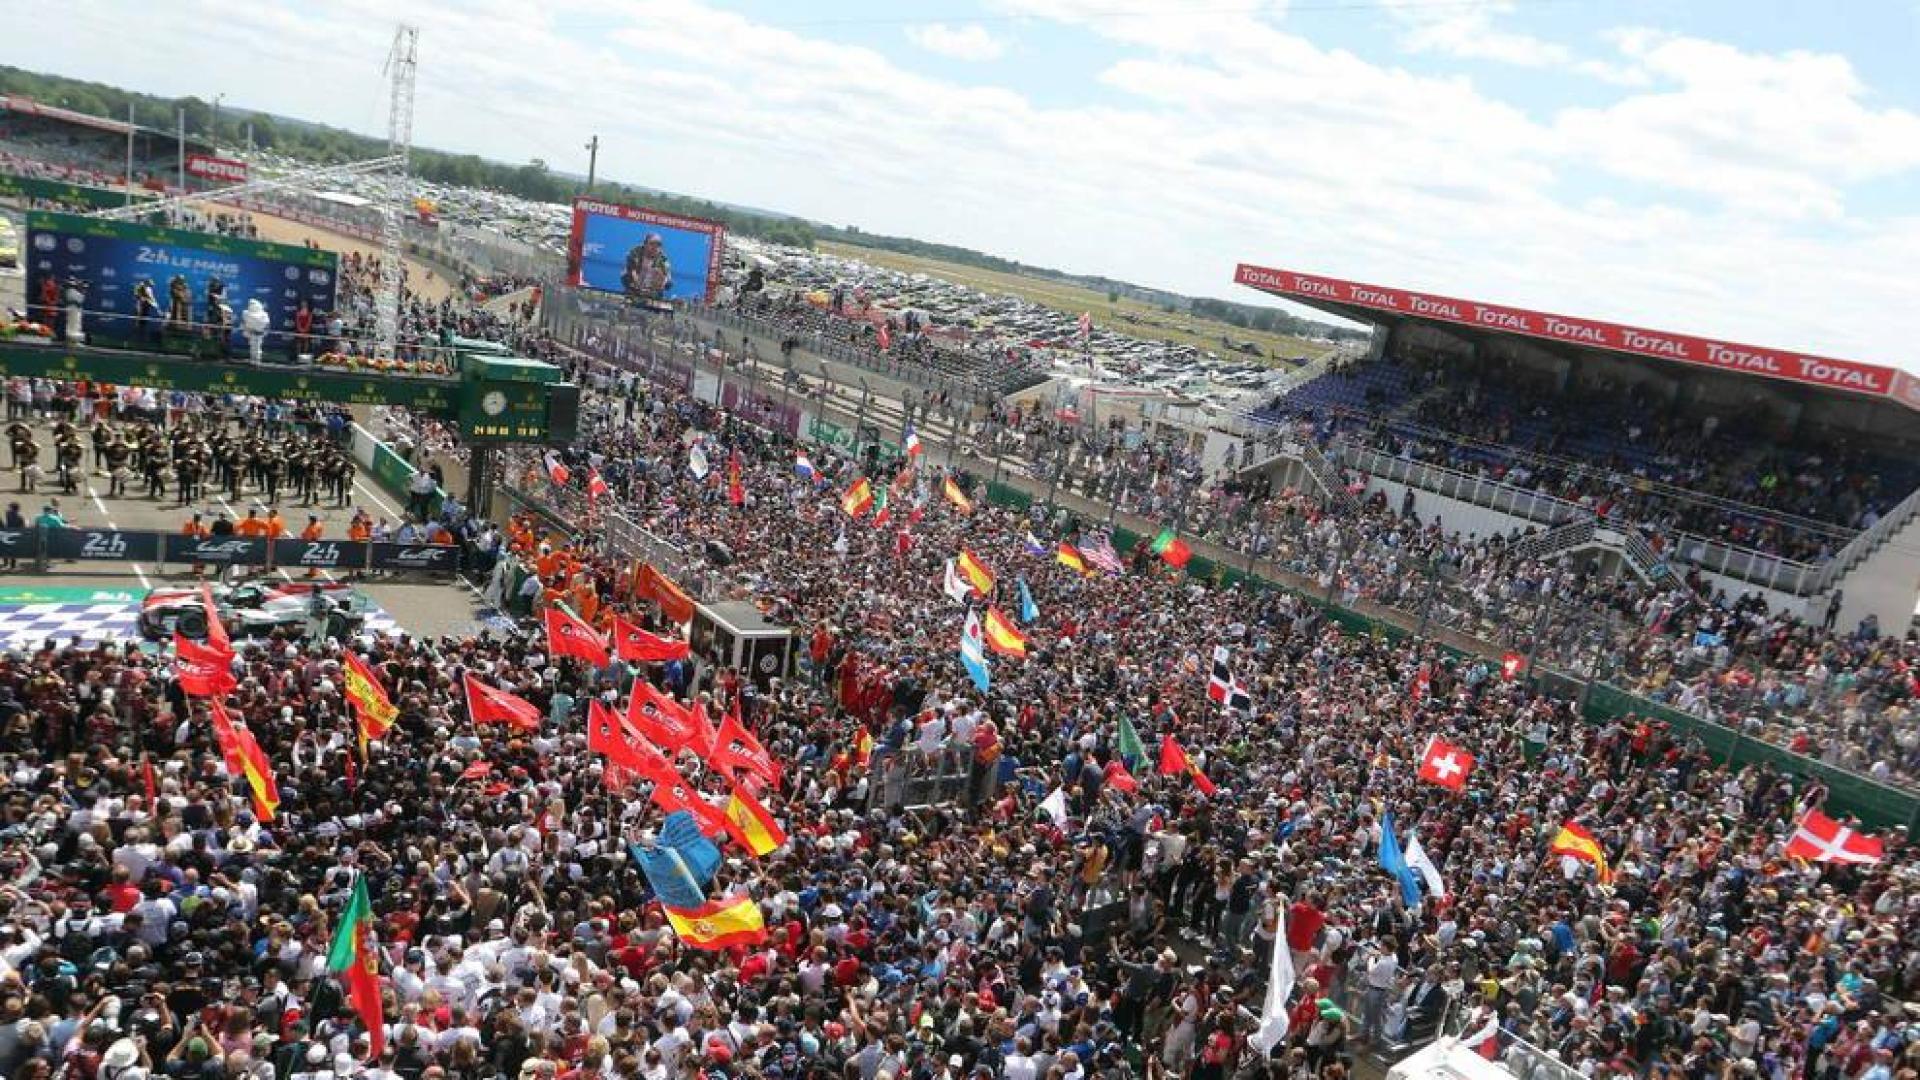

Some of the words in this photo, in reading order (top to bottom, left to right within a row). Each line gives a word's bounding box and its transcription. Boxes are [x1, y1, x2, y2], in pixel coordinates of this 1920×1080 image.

[191, 158, 246, 178] MOTUL
[577, 200, 620, 216] MOTUL
[1243, 268, 1282, 288] TOTAL
[1294, 277, 1338, 297] TOTAL
[1350, 286, 1397, 307] TOTAL
[1409, 295, 1460, 319] TOTAL
[1474, 306, 1530, 330] TOTAL
[1544, 317, 1606, 342] TOTAL
[1622, 329, 1689, 356] TOTAL
[1706, 342, 1780, 371] TOTAL
[1800, 358, 1881, 389] TOTAL
